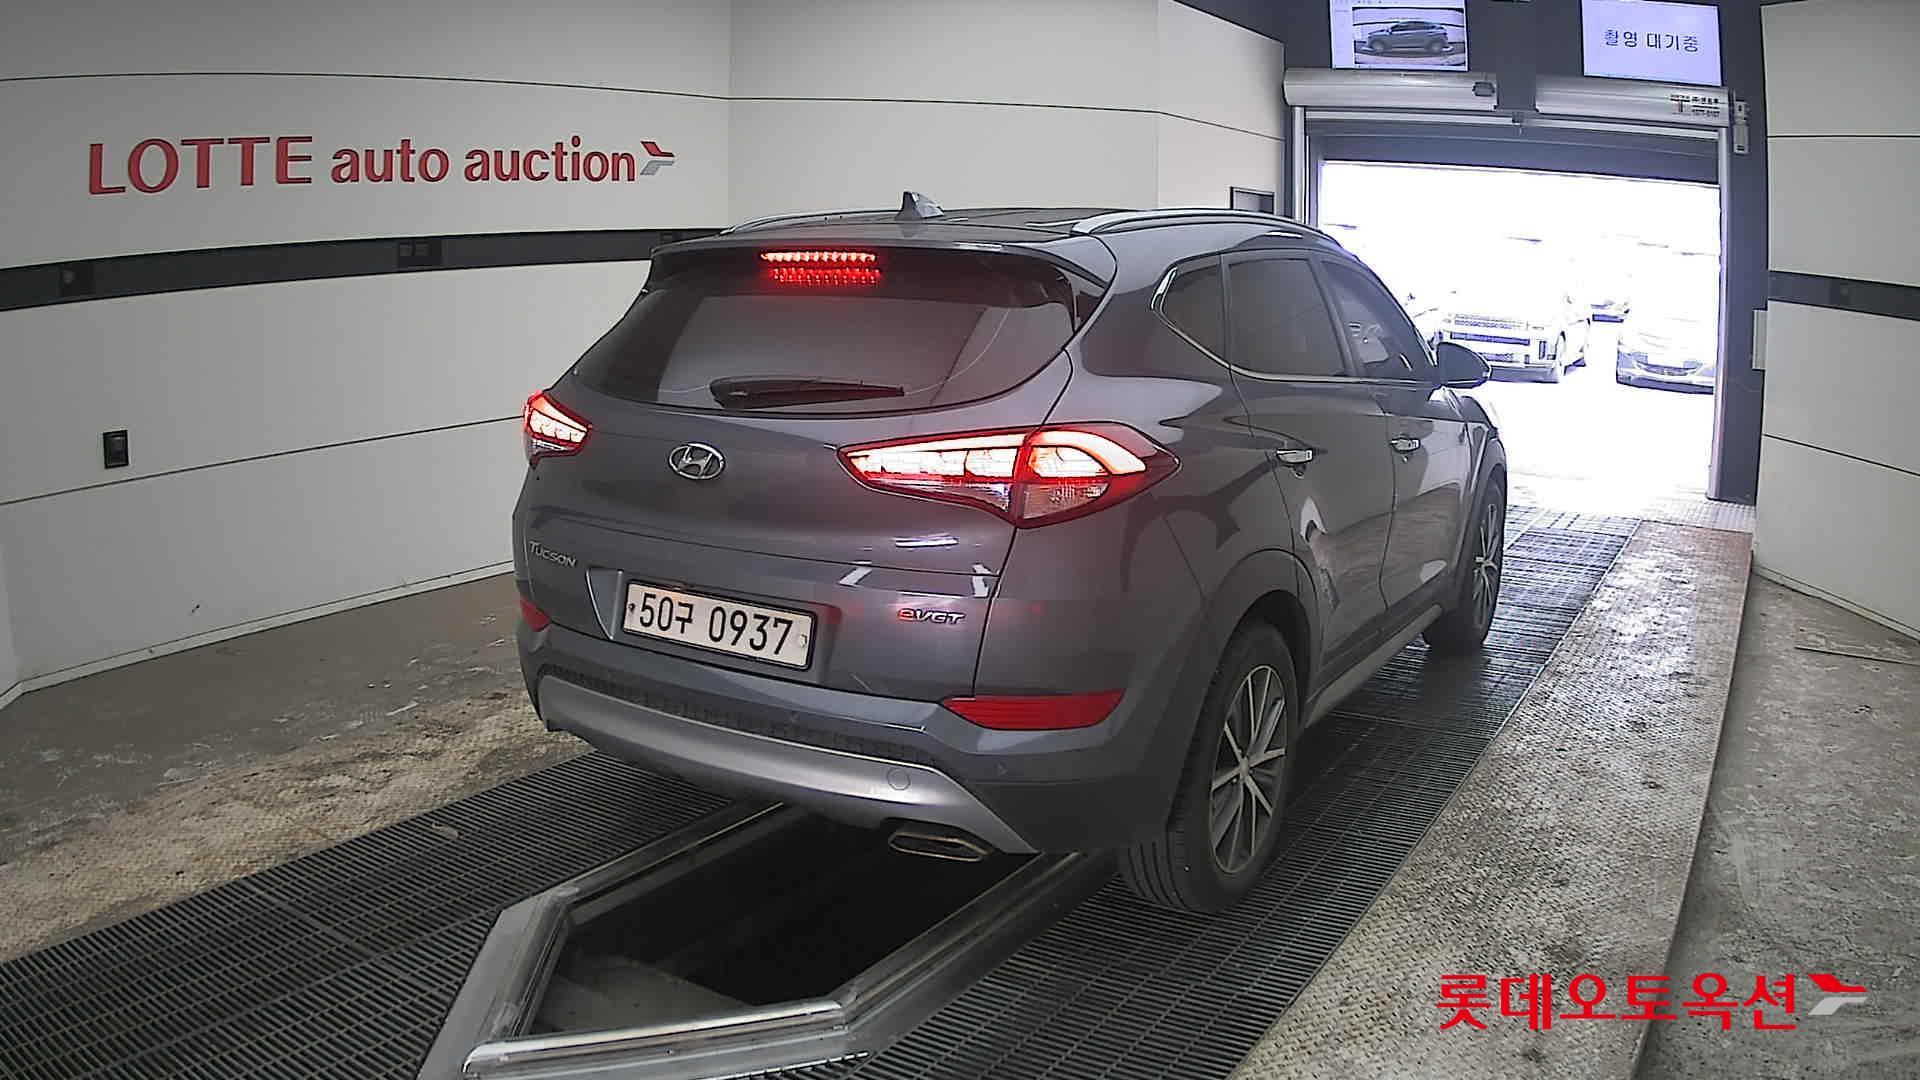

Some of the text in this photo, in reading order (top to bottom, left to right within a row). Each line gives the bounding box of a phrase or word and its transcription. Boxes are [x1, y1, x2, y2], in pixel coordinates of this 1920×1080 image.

[1646, 32, 1699, 53] 대기중
[89, 135, 637, 195] LOTTE auto auction
[528, 540, 577, 568] TUCSON
[639, 592, 793, 655] 50구 0937
